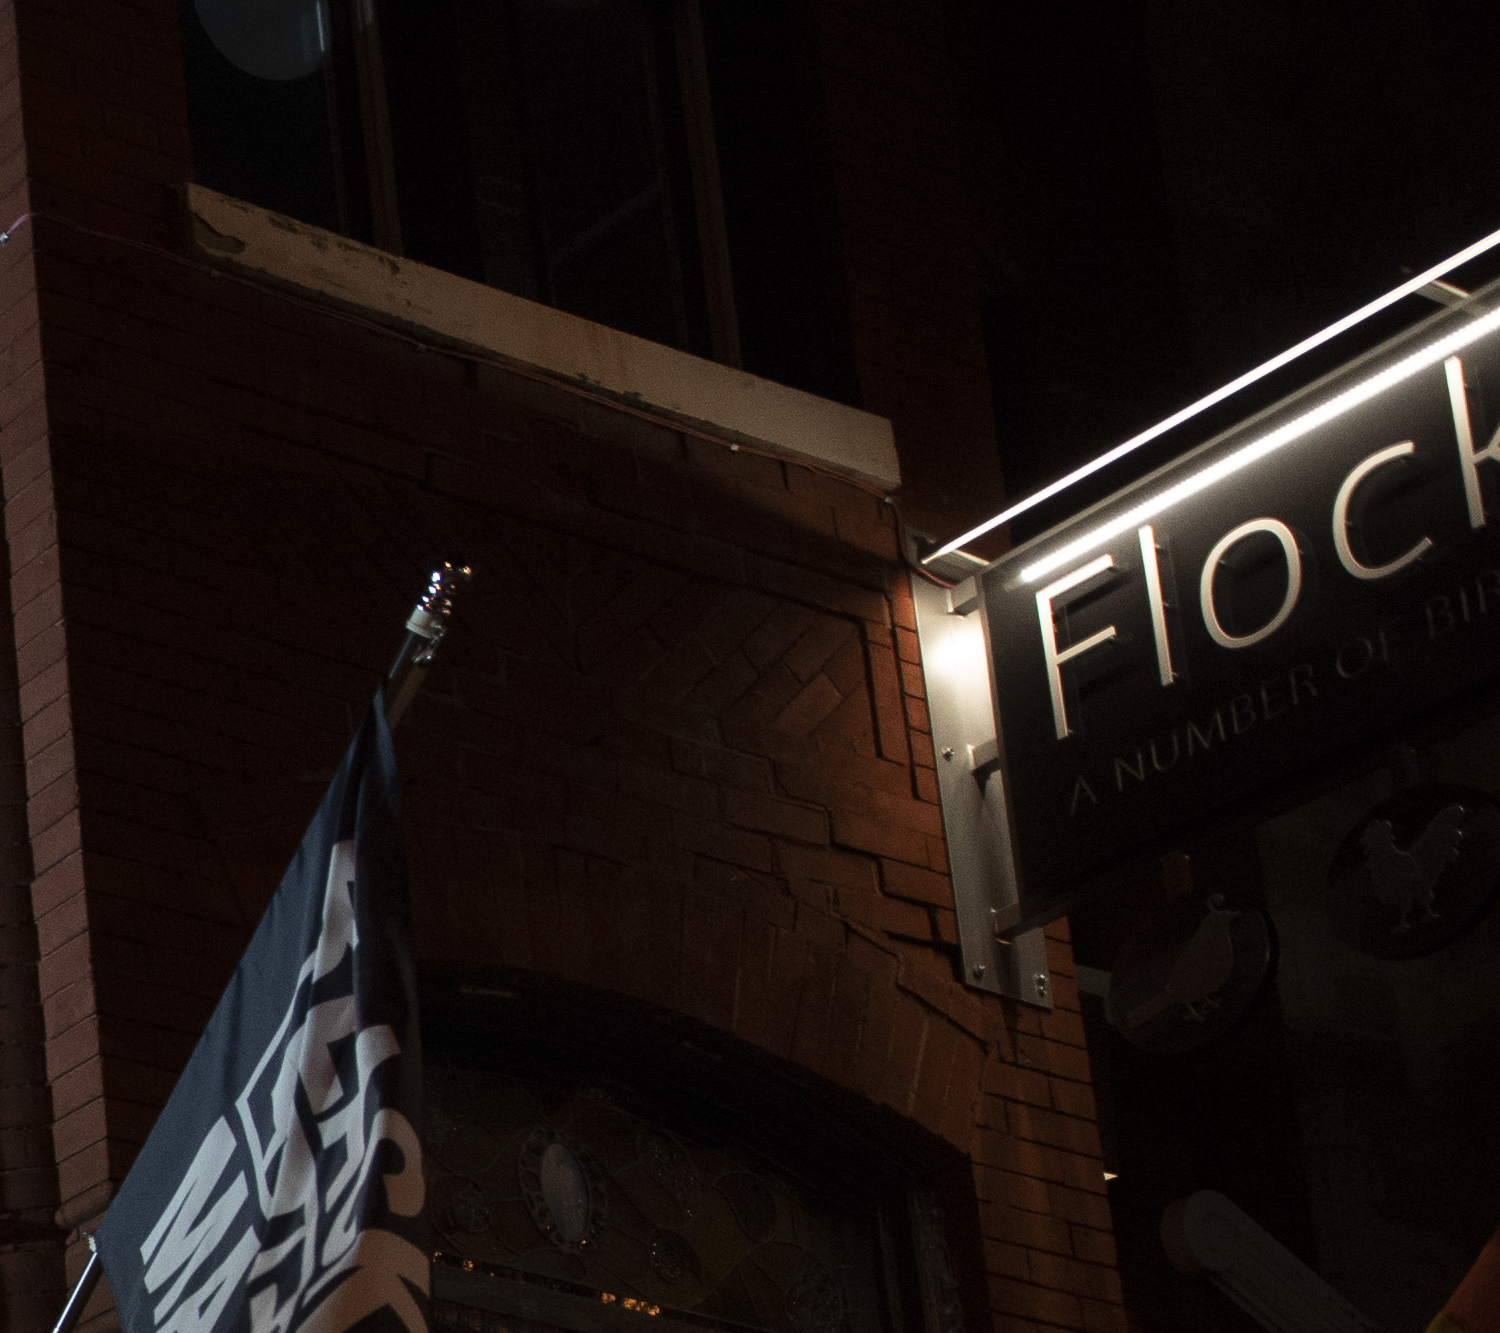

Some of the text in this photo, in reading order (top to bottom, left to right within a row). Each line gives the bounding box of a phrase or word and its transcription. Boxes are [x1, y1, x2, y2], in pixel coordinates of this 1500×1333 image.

[1035, 355, 1500, 741] Flock
[1070, 775, 1098, 817] A
[1112, 662, 1322, 793] NUMBER
